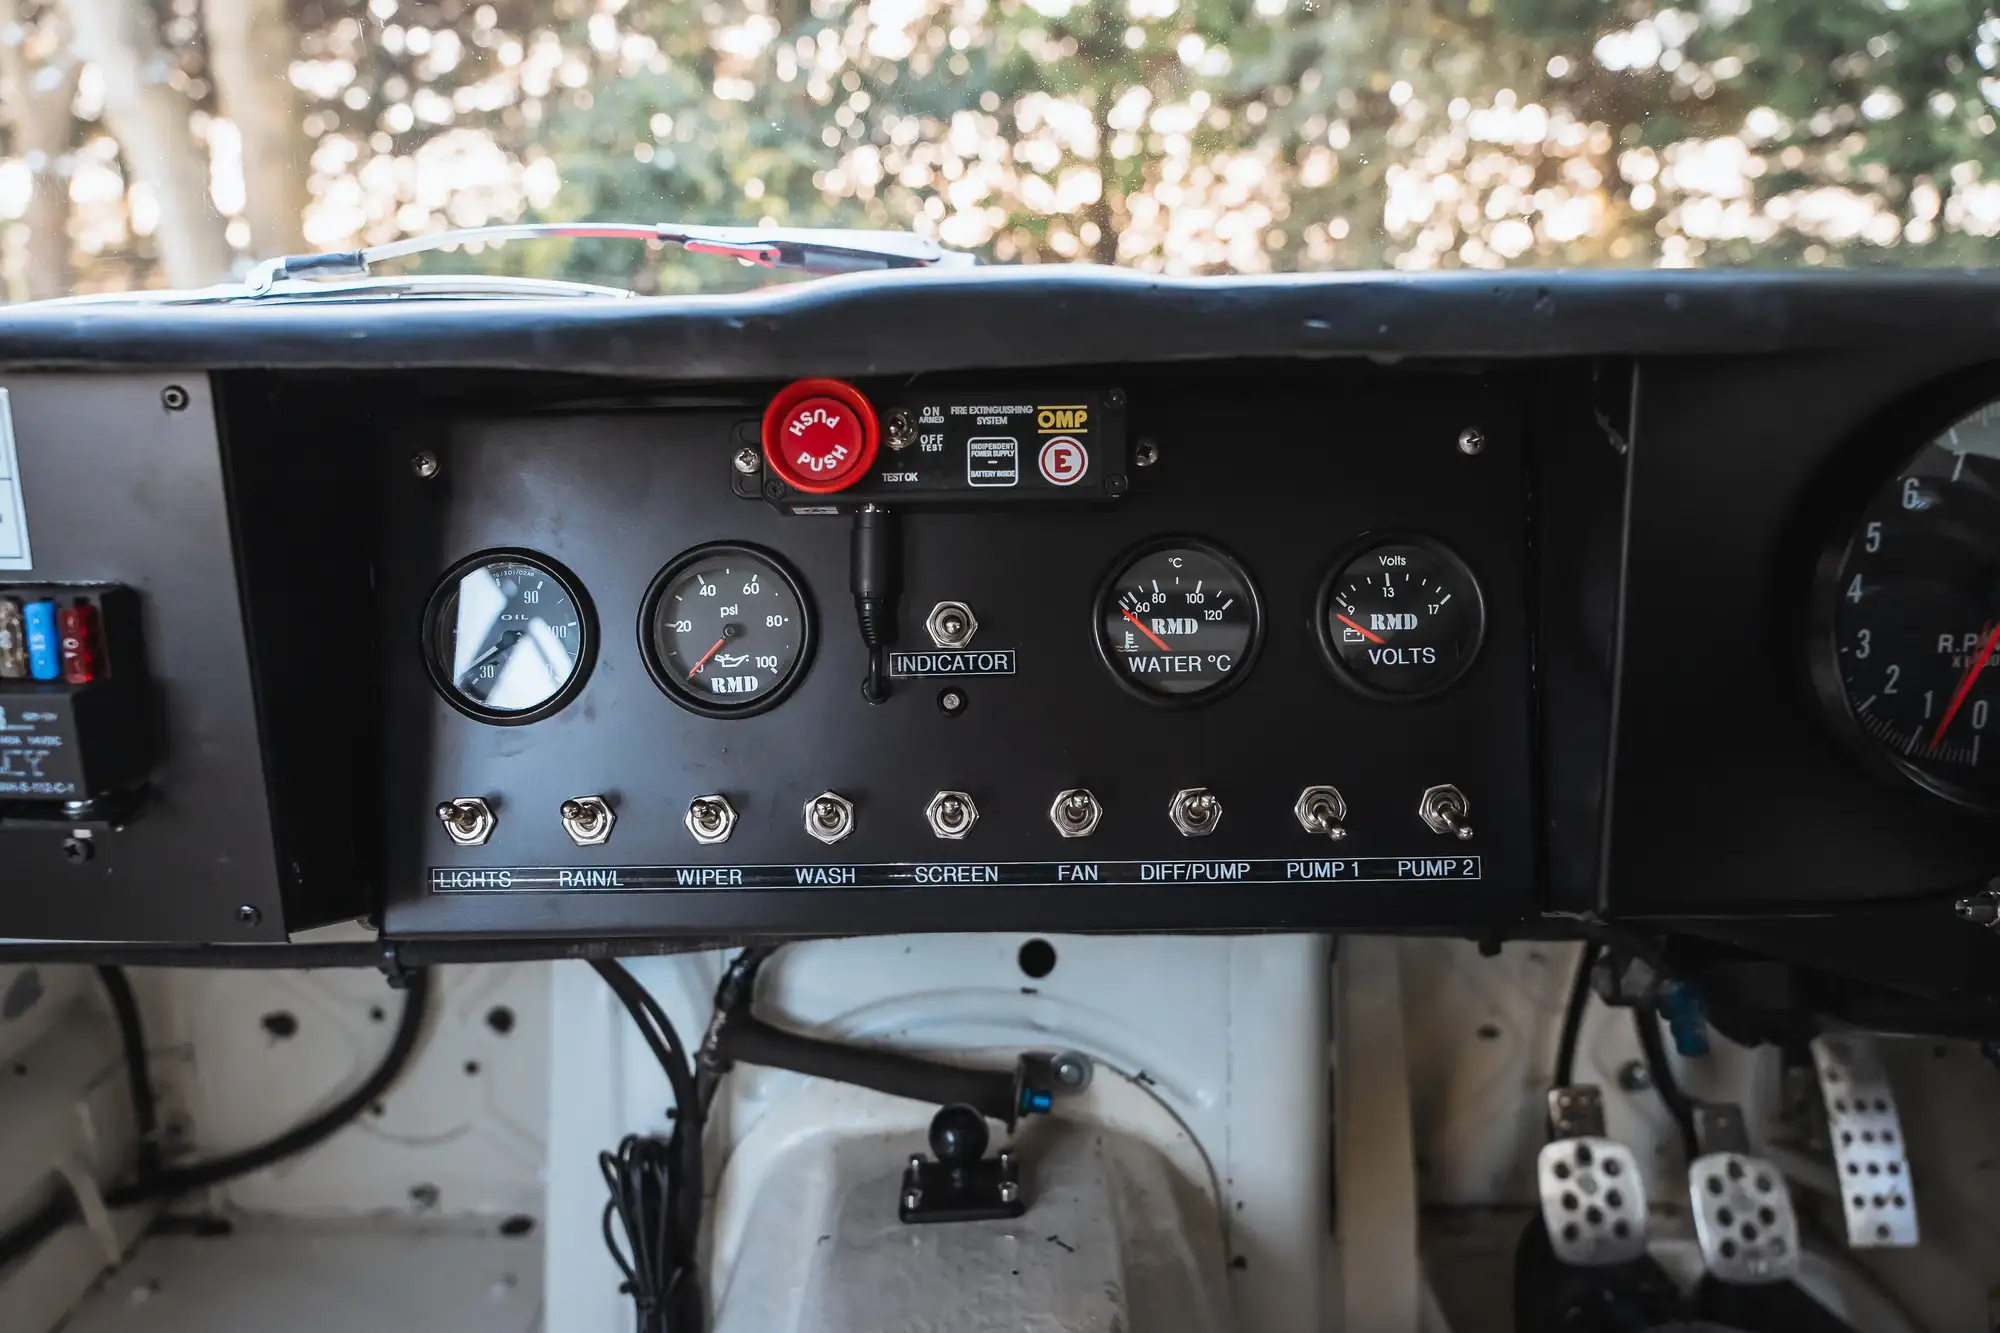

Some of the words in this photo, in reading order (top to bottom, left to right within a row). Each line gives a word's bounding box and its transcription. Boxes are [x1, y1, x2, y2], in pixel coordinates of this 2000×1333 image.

[923, 407, 940, 416] ON
[951, 406, 967, 415] FIRE
[969, 405, 1033, 414] EXTINGUISHING
[789, 408, 840, 437] PUSH
[919, 416, 944, 424] ARMED
[977, 417, 1008, 425] SYSTEM
[1038, 411, 1088, 428] OMP
[920, 434, 943, 445] OFF
[796, 444, 848, 472] PUSH
[1054, 449, 1072, 473] E
[882, 473, 904, 482] TEST
[904, 472, 918, 482] OK
[996, 470, 1015, 478] INSIDE
[1903, 477, 1920, 509] 6
[1865, 522, 1881, 552] 5
[1379, 556, 1406, 566] Volts
[699, 584, 716, 596] 40
[743, 583, 759, 595] 60
[1382, 587, 1394, 597] 13
[1847, 574, 1863, 603] 4
[524, 591, 539, 603] 90
[1152, 593, 1166, 603] 80
[1186, 593, 1204, 604] 100
[720, 604, 738, 618] psi
[1135, 602, 1150, 612] 60
[1347, 605, 1355, 615] 9
[1428, 605, 1439, 615] 17
[766, 615, 782, 627] 80
[1204, 610, 1222, 621] 120
[676, 620, 691, 632] 20
[1151, 618, 1199, 635] RMD
[1371, 614, 1418, 630] RMD
[1856, 629, 1871, 659] 3
[755, 656, 777, 668] 100
[1369, 647, 1436, 665] VOLTS
[897, 654, 1008, 672] INDICATOR
[1129, 656, 1202, 673] WATER
[480, 666, 494, 678] 30
[711, 676, 758, 693] RMD
[1884, 665, 1900, 694] 2
[1924, 690, 1933, 719] 1
[1972, 700, 1988, 729] 0
[440, 871, 511, 888] LIGHTS
[559, 870, 624, 887] RAIN/L
[676, 869, 743, 885] WIPER
[795, 868, 856, 884] WASH
[914, 866, 999, 883] SCREEN
[1058, 864, 1098, 881] FAN
[1141, 863, 1250, 880] DIFF/PUMP
[1287, 861, 1345, 878] PUMP
[1351, 861, 1359, 877] 1
[1398, 859, 1456, 877] PUMP
[1462, 859, 1474, 876] 2
